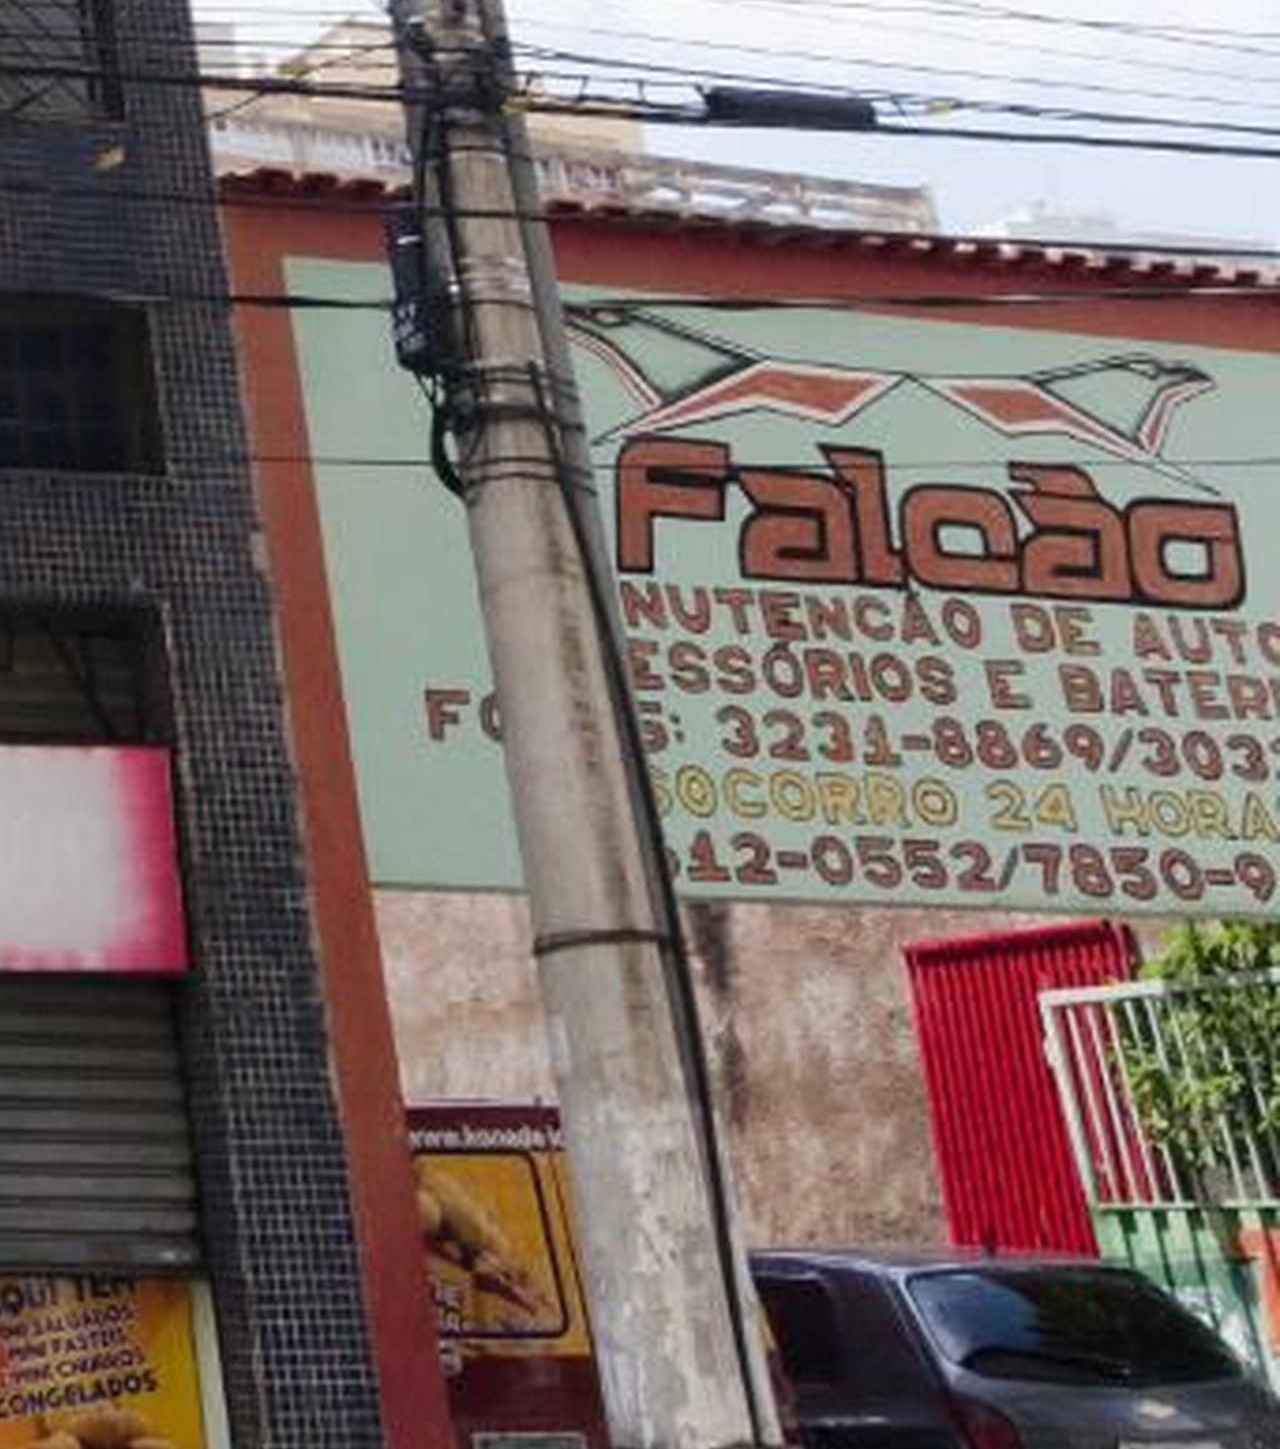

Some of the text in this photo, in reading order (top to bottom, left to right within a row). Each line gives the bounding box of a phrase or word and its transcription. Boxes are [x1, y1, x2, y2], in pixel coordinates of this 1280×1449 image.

[1010, 603, 1101, 655] DE
[626, 636, 959, 705] ESSÓRIOS
[984, 659, 1032, 709] E
[983, 779, 1078, 832] 24
[1099, 783, 1280, 842] HORA
